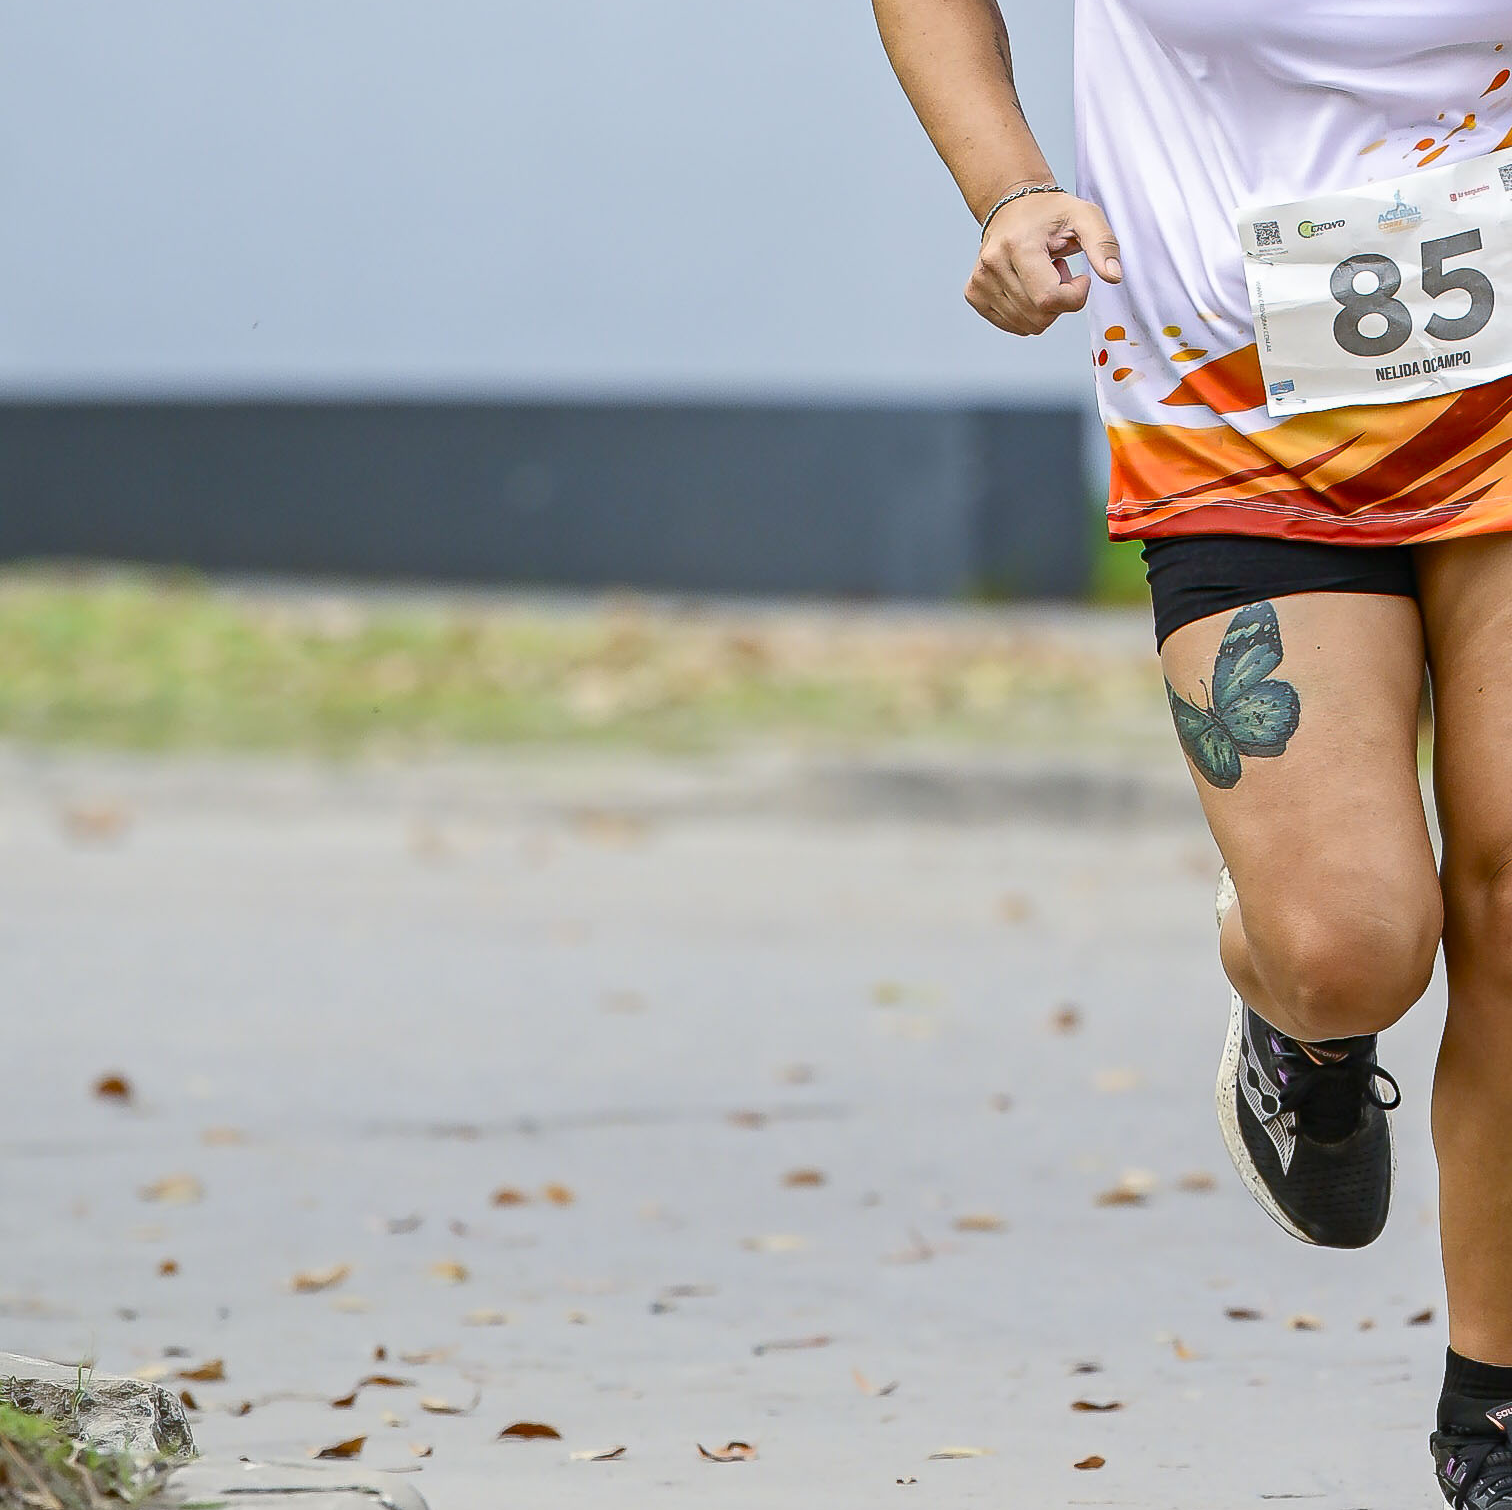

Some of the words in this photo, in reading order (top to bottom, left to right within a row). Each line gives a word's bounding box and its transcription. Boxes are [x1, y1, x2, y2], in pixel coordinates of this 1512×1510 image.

[1330, 228, 1494, 357] 85
[1375, 361, 1420, 381] NELIDA
[1422, 350, 1471, 374] OCAMPO
